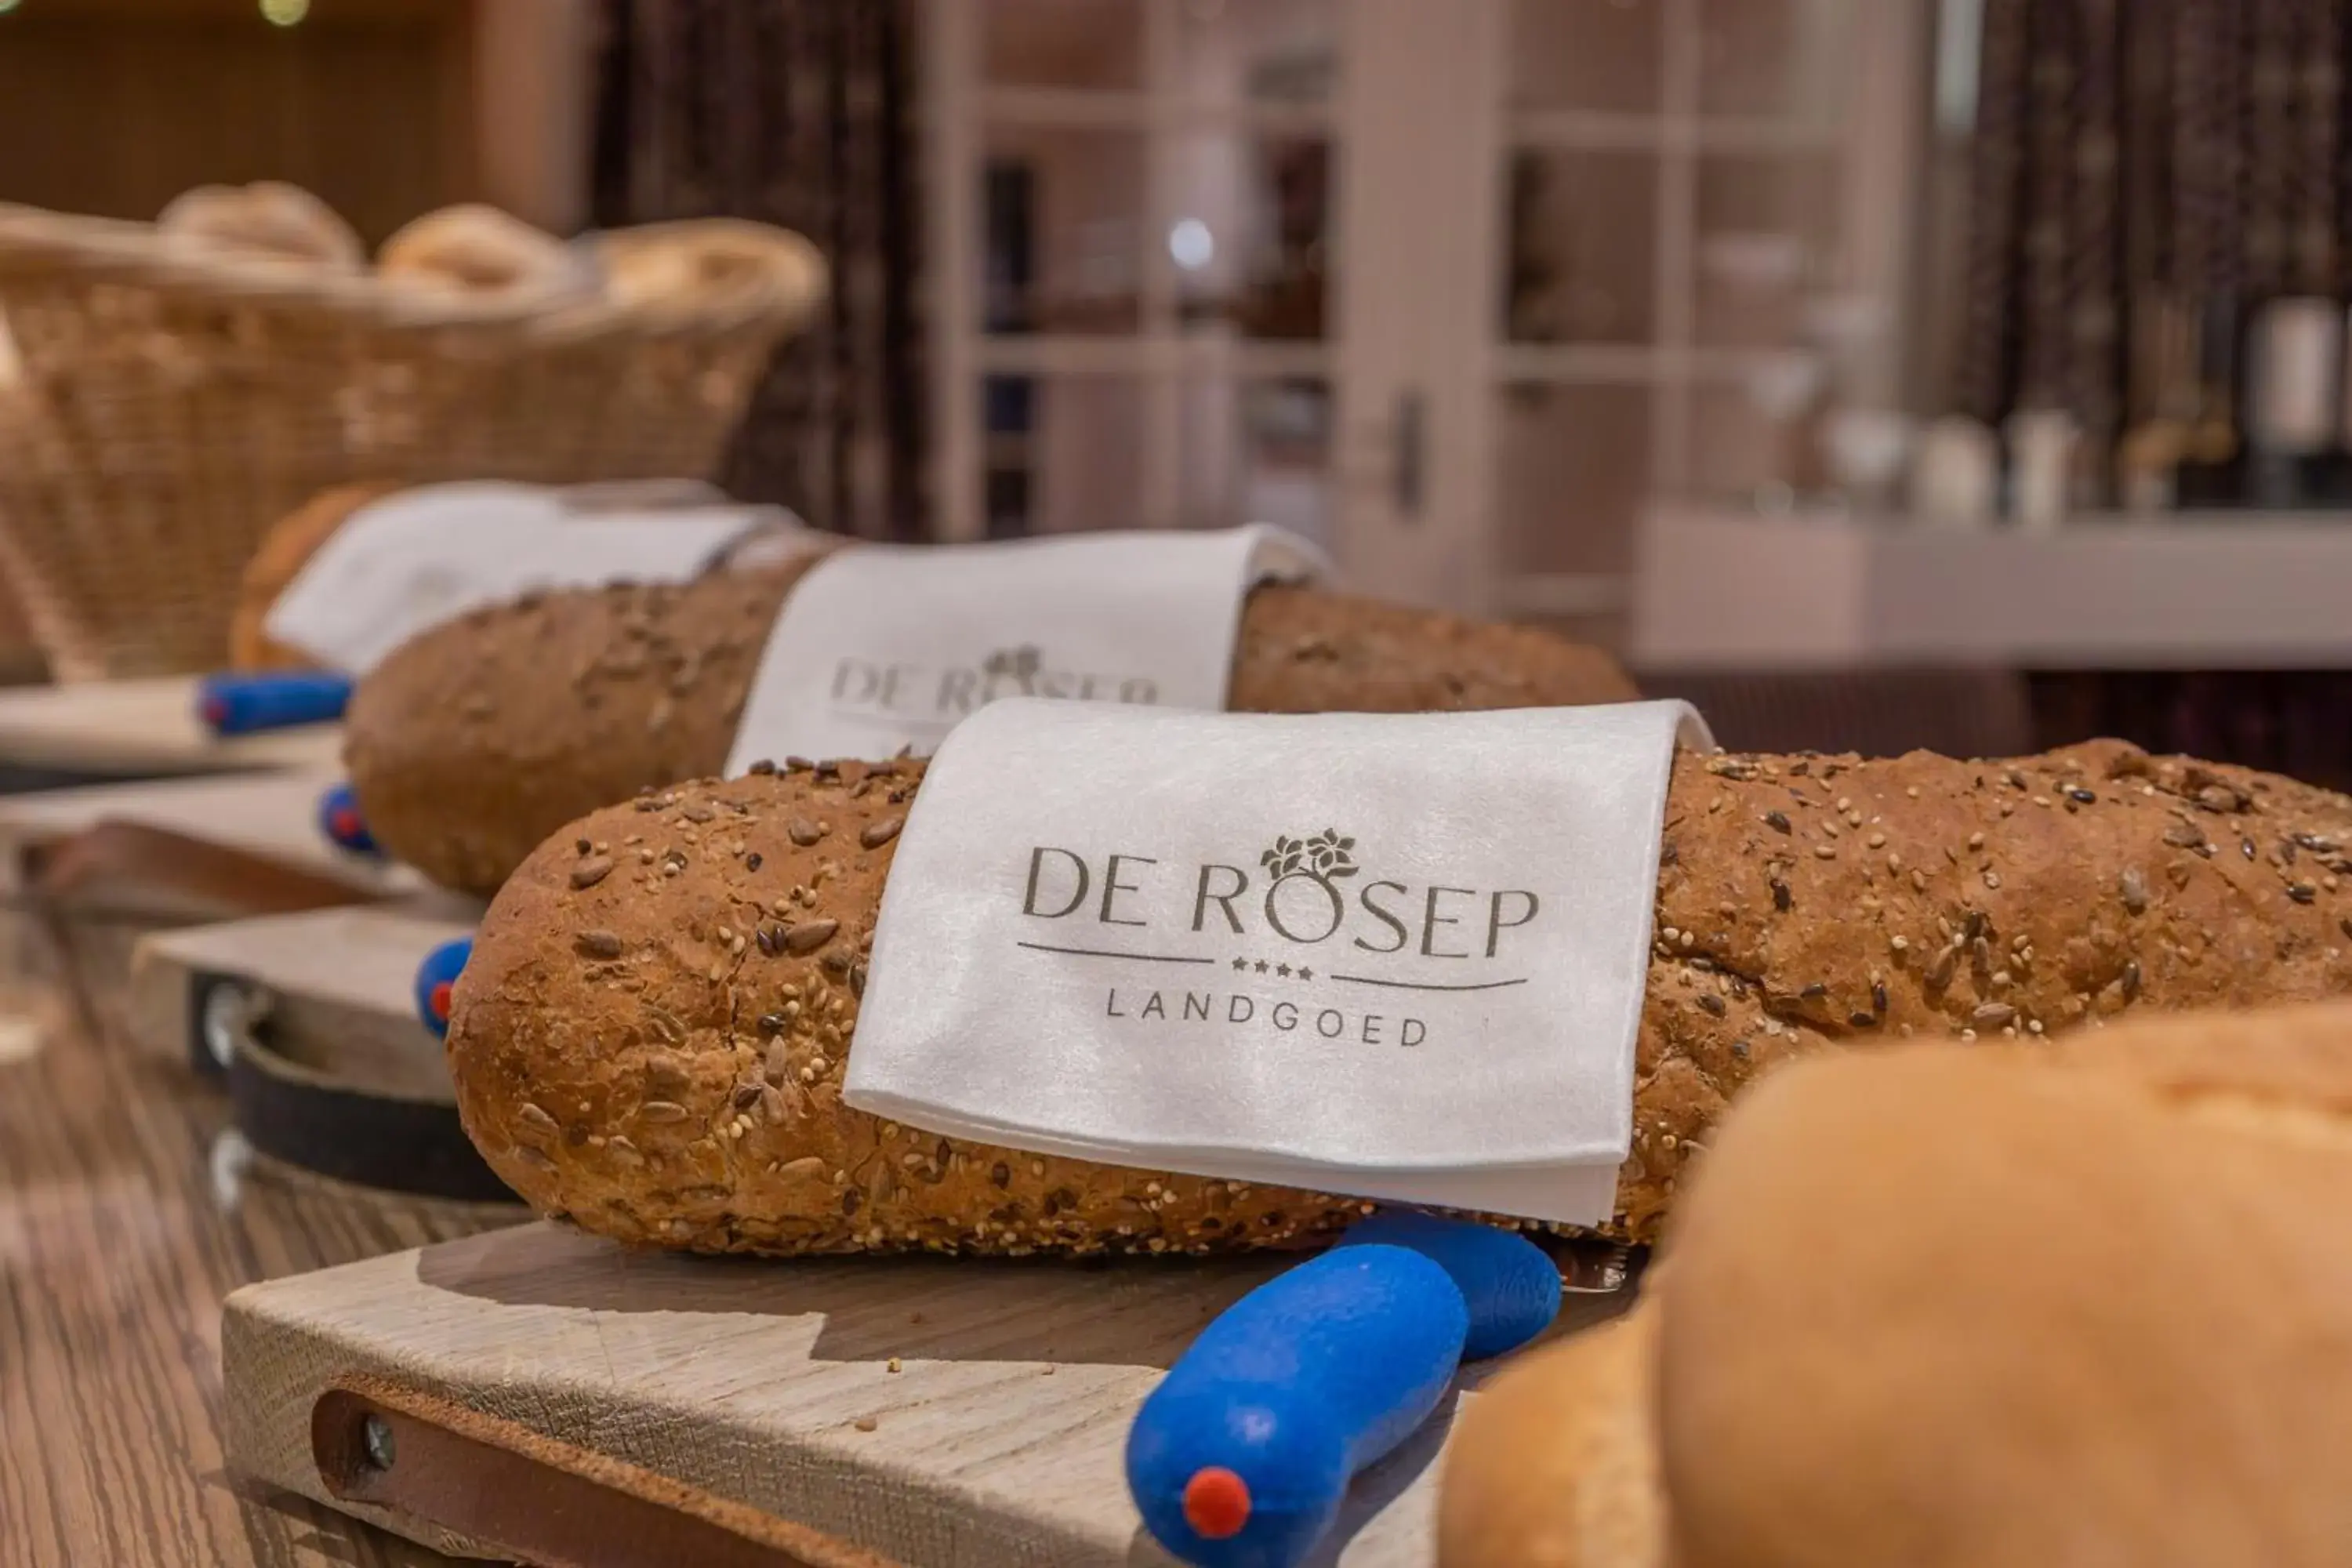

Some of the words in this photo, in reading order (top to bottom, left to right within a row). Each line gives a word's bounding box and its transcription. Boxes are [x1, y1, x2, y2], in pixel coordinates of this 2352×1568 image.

[830, 656, 925, 706] DE
[1022, 846, 1157, 927] DE
[1191, 863, 1540, 958] ROSEP
[1106, 988, 1427, 1047] LANDGOED
